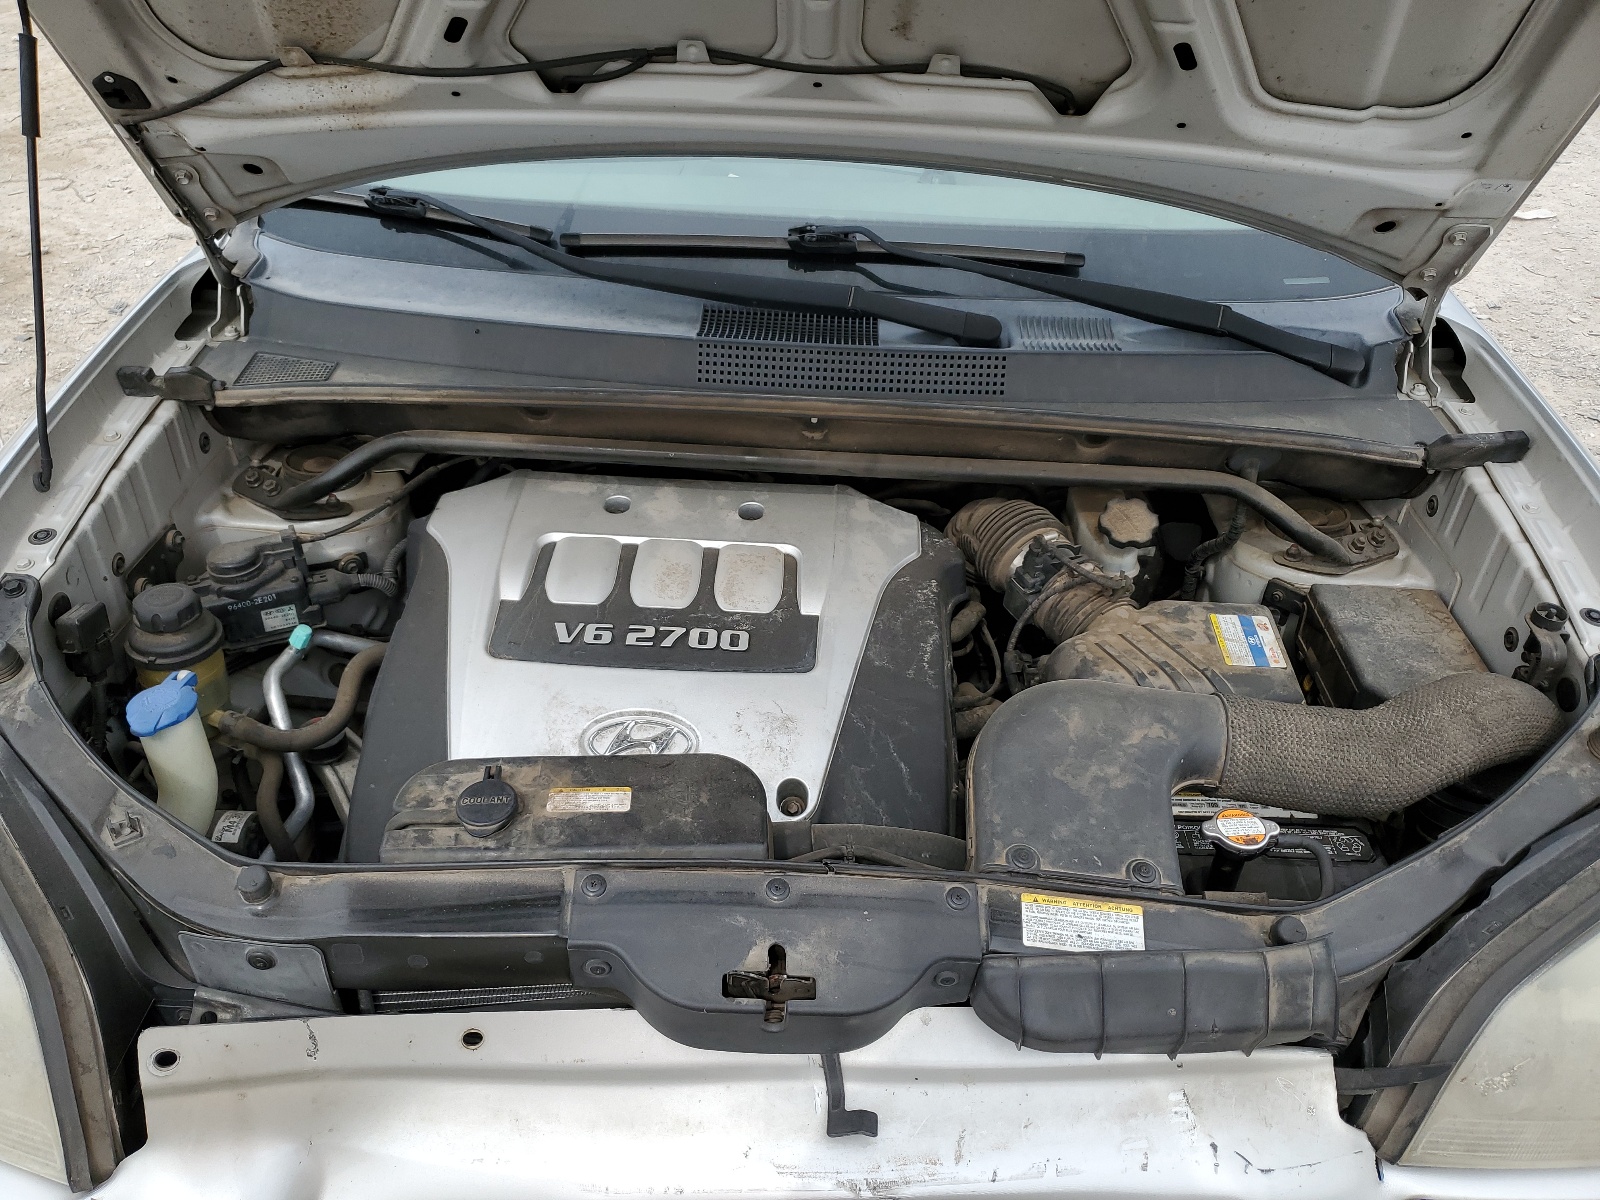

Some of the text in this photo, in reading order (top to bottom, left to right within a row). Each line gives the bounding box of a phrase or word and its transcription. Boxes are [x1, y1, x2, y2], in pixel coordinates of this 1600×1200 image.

[554, 622, 750, 652] V6 2700
[460, 795, 510, 806] COOLANT
[1041, 898, 1134, 914] WARNING ATTENTION ACHTUNG
